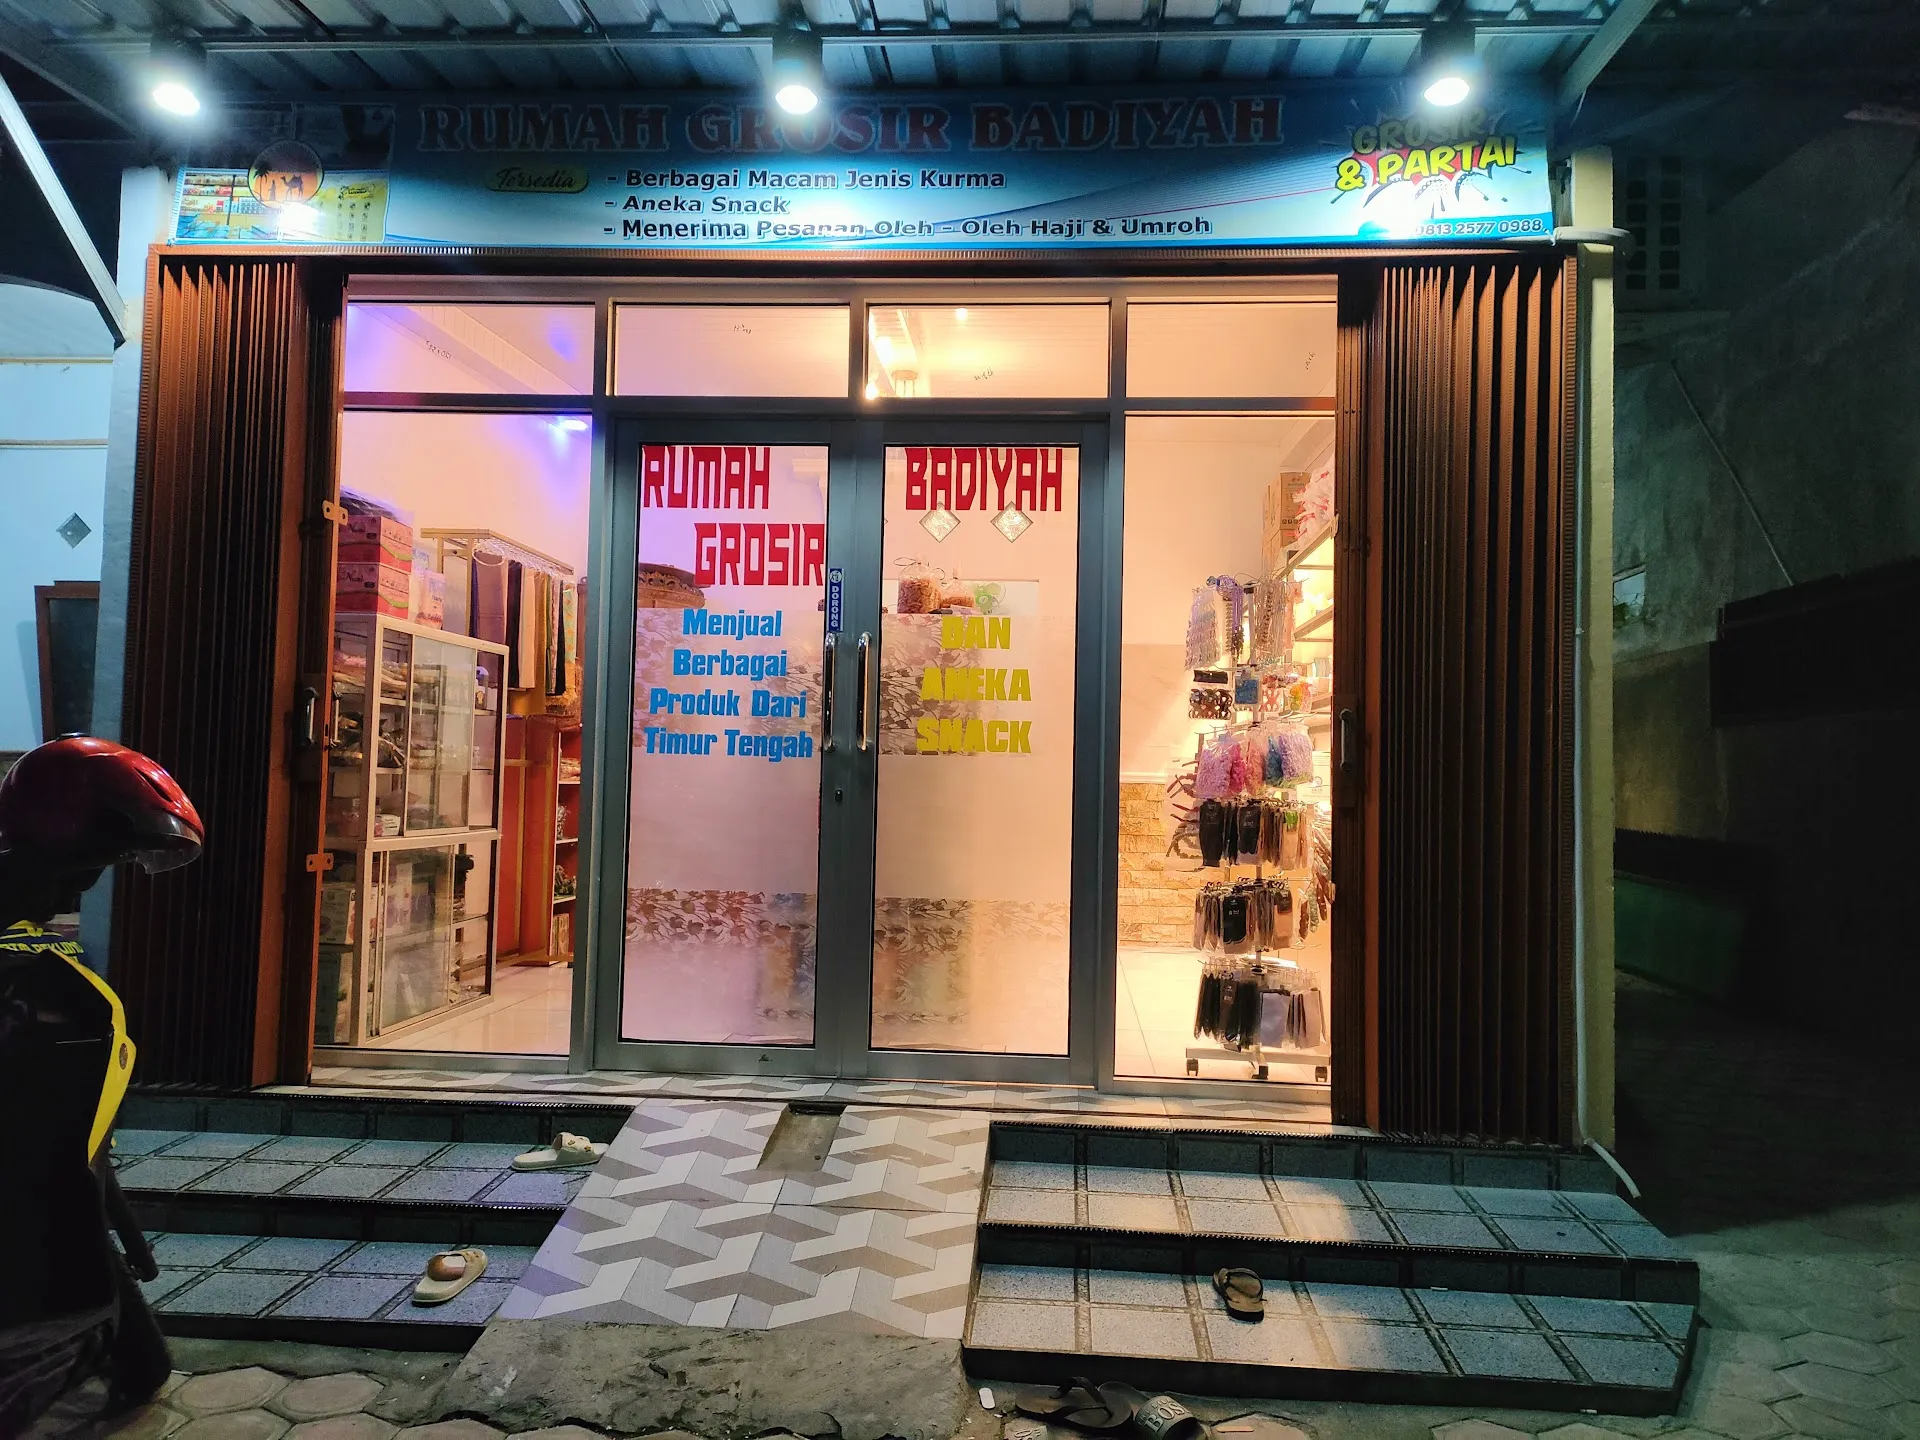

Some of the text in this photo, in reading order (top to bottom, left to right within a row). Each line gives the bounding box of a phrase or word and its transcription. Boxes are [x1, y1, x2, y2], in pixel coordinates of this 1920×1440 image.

[418, 96, 1285, 152] RUMAH GROSIR BADIYAH
[1353, 106, 1488, 154] GROSIR
[497, 167, 575, 189] Tersedia
[1335, 134, 1518, 191] & PARTAI
[626, 169, 739, 190] Berbagai
[749, 170, 836, 188] Macam
[845, 170, 912, 188] Jenis
[921, 169, 1005, 188] Kurma
[622, 195, 703, 212] Aneka
[711, 195, 788, 213] Snack
[623, 219, 746, 238] Menerima
[757, 220, 865, 237] Pesanan
[874, 220, 932, 235] Oleh
[961, 219, 1021, 235] Oleh
[1031, 219, 1082, 238] Haji
[1092, 219, 1110, 235] &
[1122, 217, 1211, 234] Umroh
[1456, 222, 1493, 234] 2577
[1499, 220, 1542, 232] 0988
[643, 446, 770, 509] RUMAH
[905, 448, 1063, 511] BADIYAH
[694, 523, 825, 586] GROSIR
[831, 585, 839, 628] DORONG
[683, 609, 782, 640] Menjual
[941, 617, 1011, 649] DAN
[673, 648, 787, 681] Berbagai
[921, 668, 1032, 701] ANEKA
[650, 687, 806, 718] Produk Dari
[644, 727, 813, 762] Timur Tengah
[916, 719, 1032, 753] SNACK
